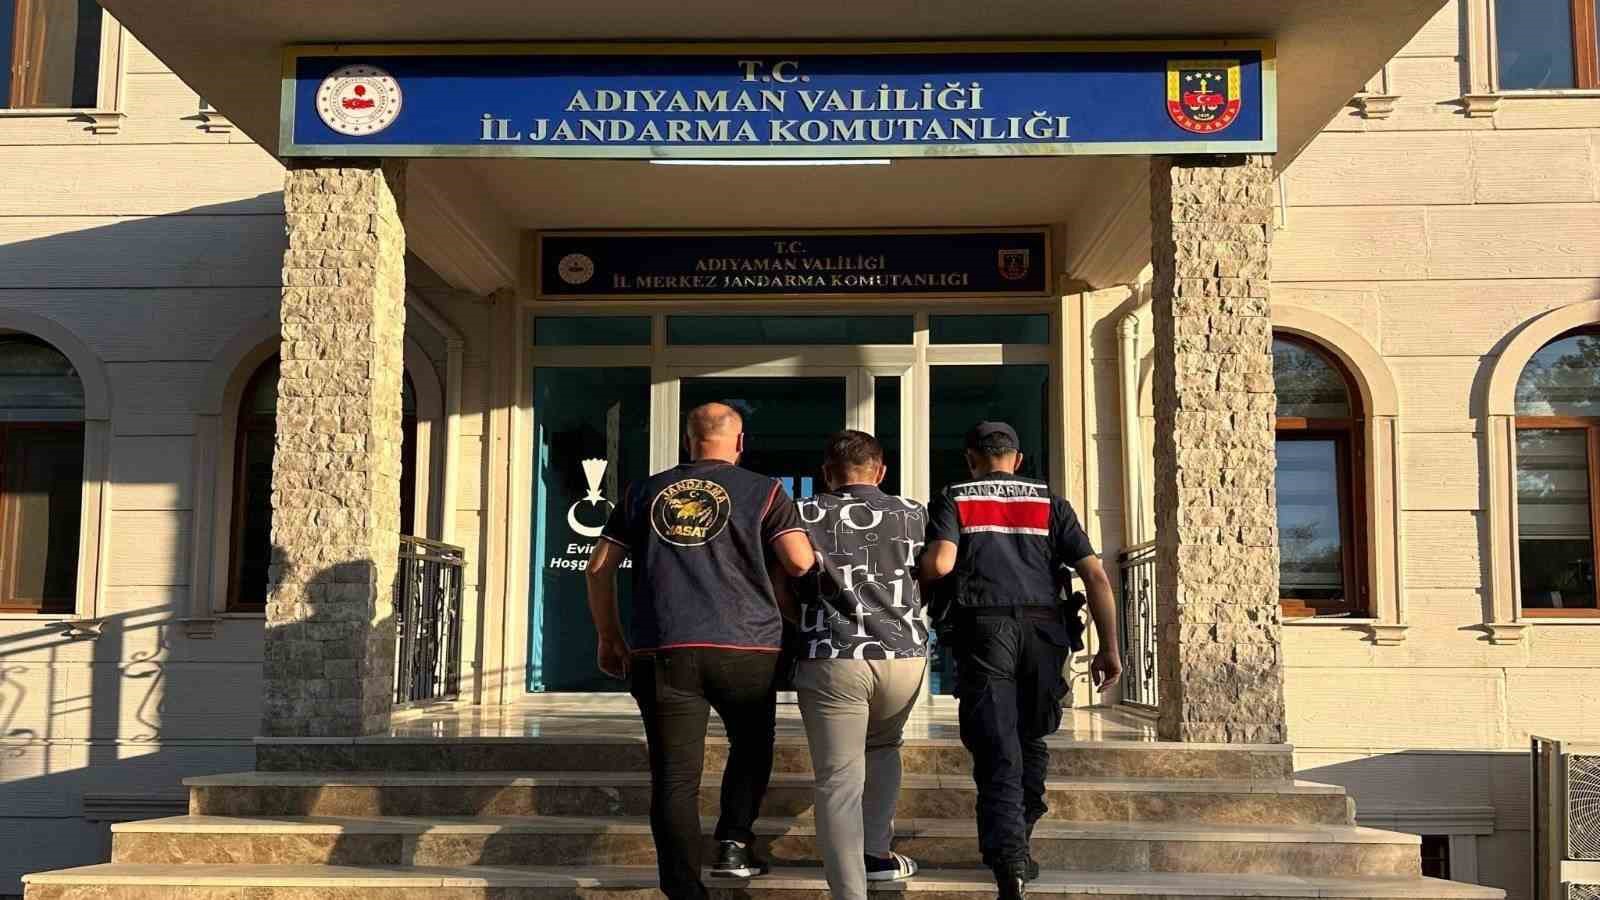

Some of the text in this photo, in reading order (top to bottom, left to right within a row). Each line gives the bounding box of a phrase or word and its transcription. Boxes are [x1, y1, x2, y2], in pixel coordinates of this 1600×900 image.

[738, 60, 811, 83] T.C.
[565, 82, 983, 113] ADIYAMAN VALİLİĞİ
[480, 111, 1071, 142] İL JANDARMA KOMUTANLIĞI
[773, 240, 807, 254] T.C.
[696, 258, 798, 271] ADIYAMAN
[636, 275, 717, 288] MERKEZ
[723, 274, 826, 288] JANDARMA
[662, 480, 729, 504] JANDARMA
[959, 484, 1039, 497] JANDARMA
